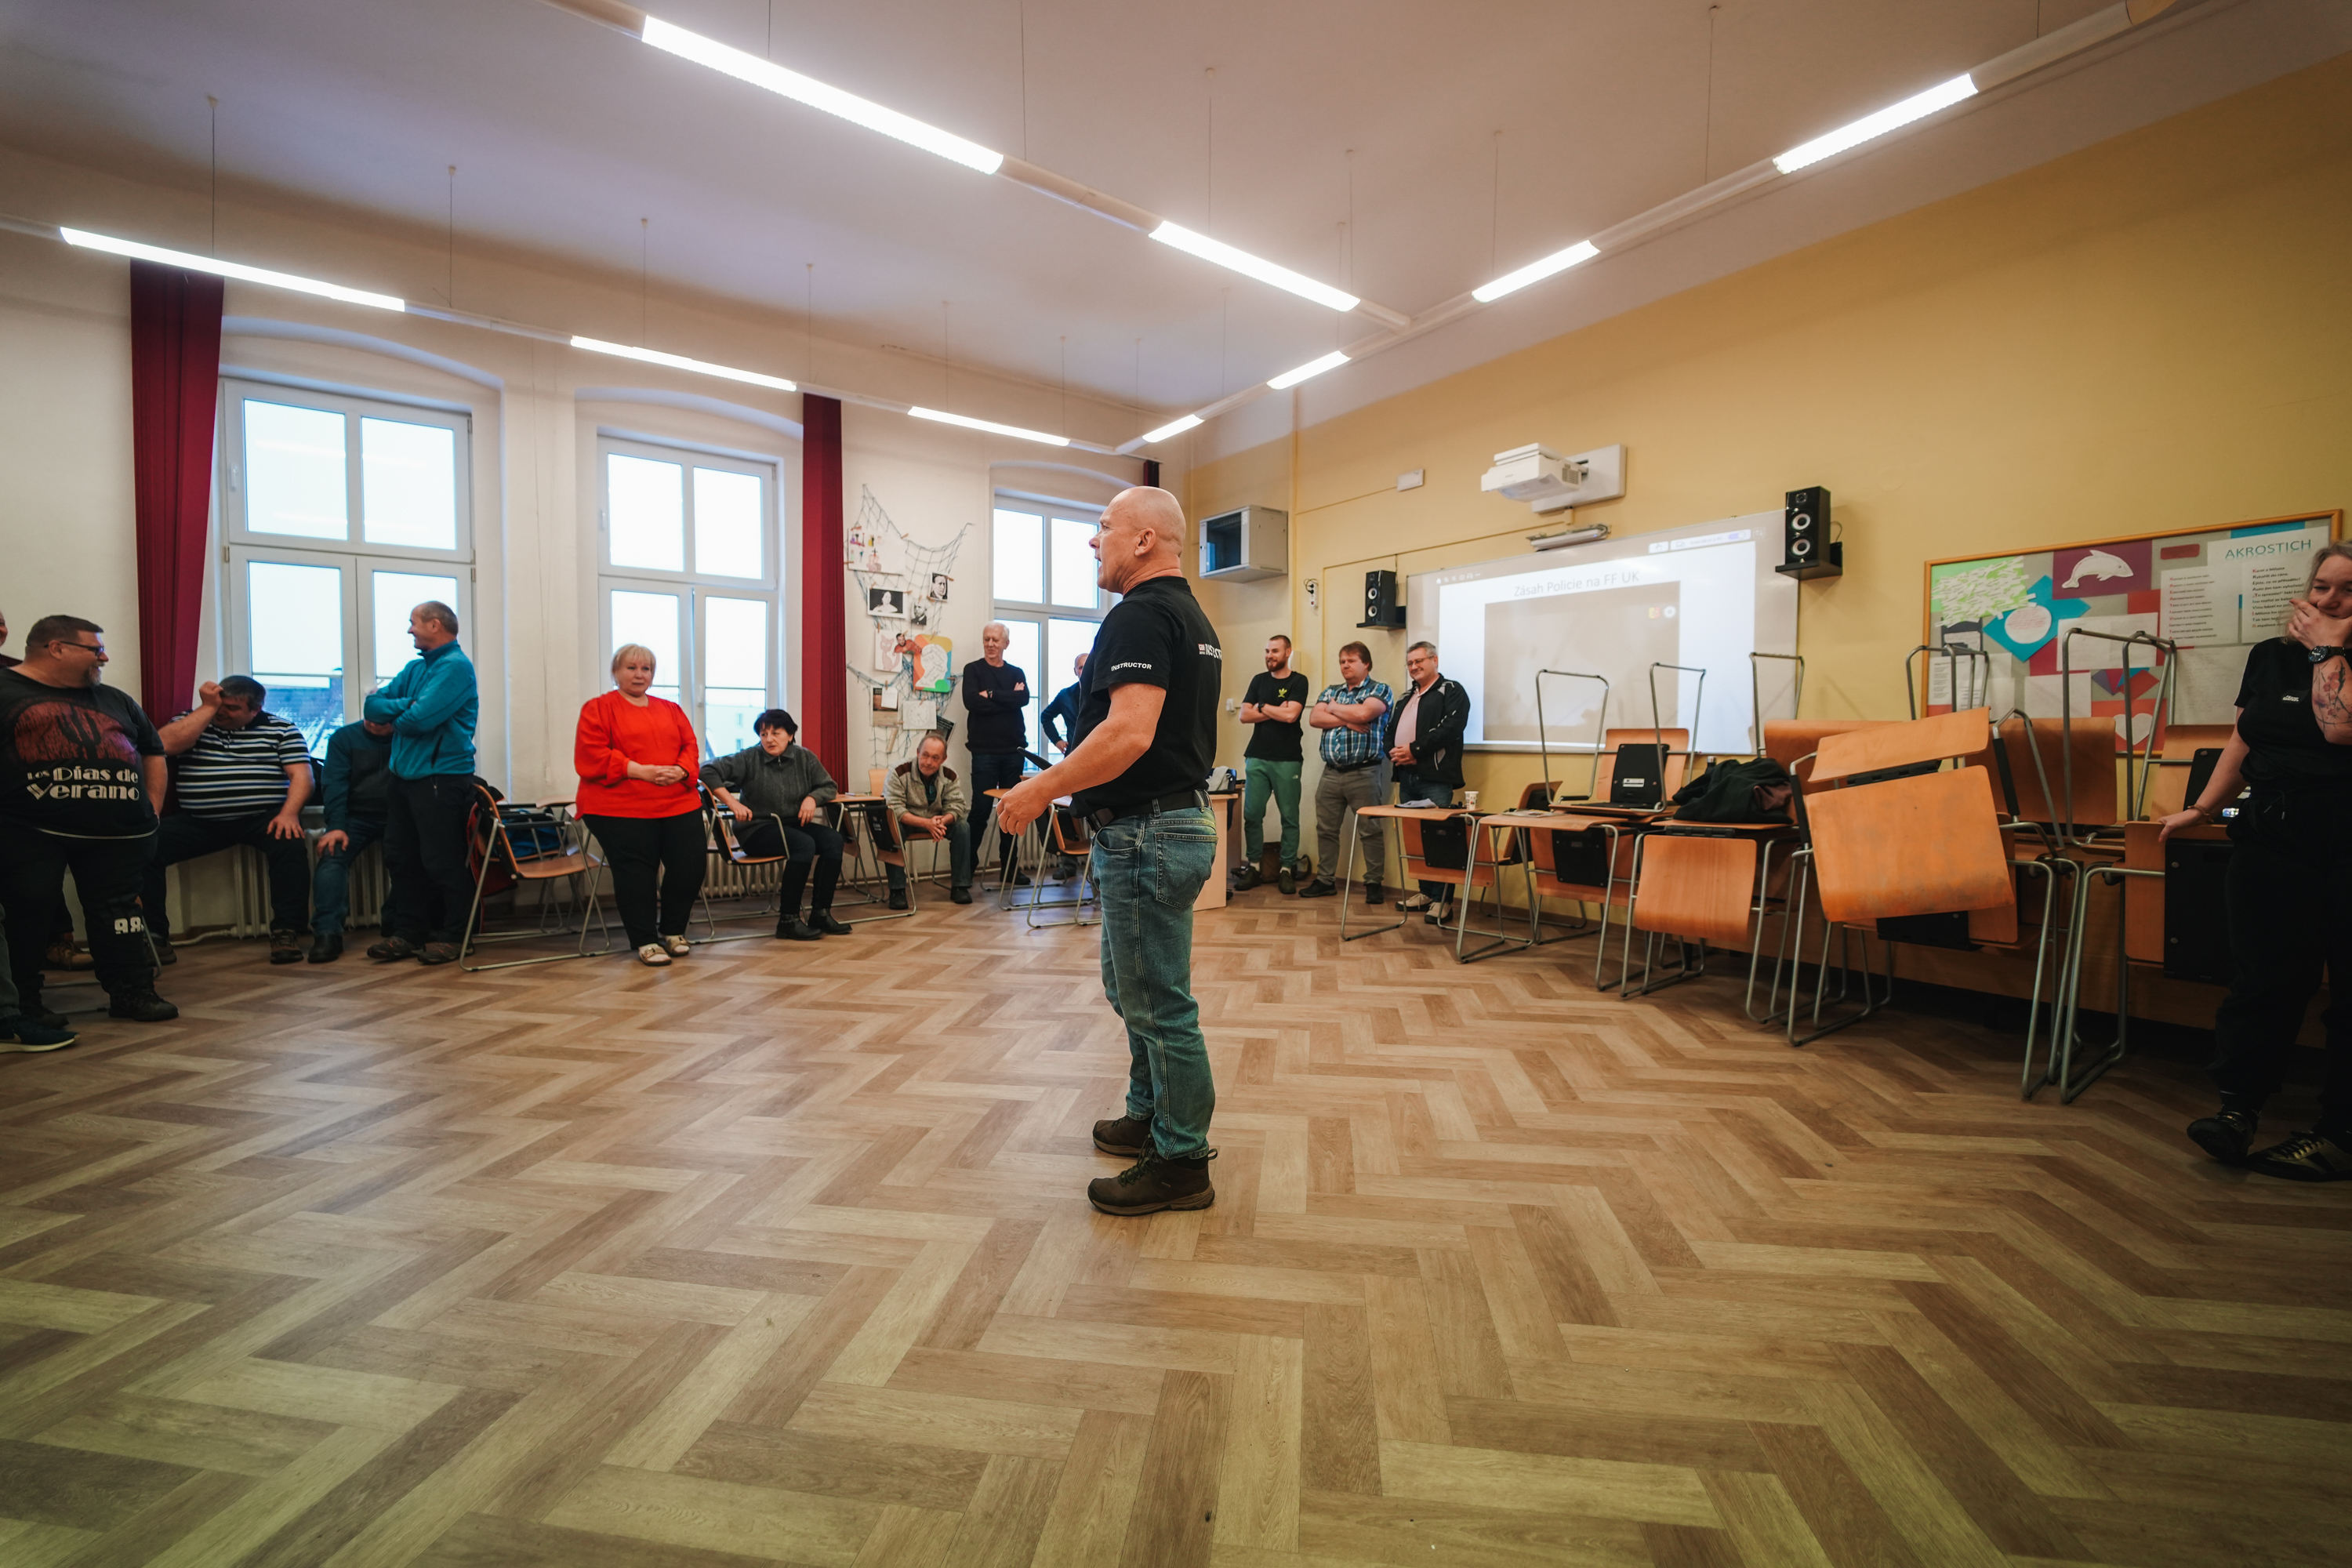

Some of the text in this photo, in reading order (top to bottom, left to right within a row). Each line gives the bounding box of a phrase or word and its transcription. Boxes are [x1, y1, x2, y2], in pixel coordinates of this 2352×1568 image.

[2225, 539, 2311, 559] AKROSTICH
[1514, 571, 1640, 597] Zásah Policie na FF UK
[1111, 662, 1152, 672] INSTRUCTOR
[53, 765, 111, 782] Días
[116, 768, 139, 783] de
[27, 782, 140, 801] Verano
